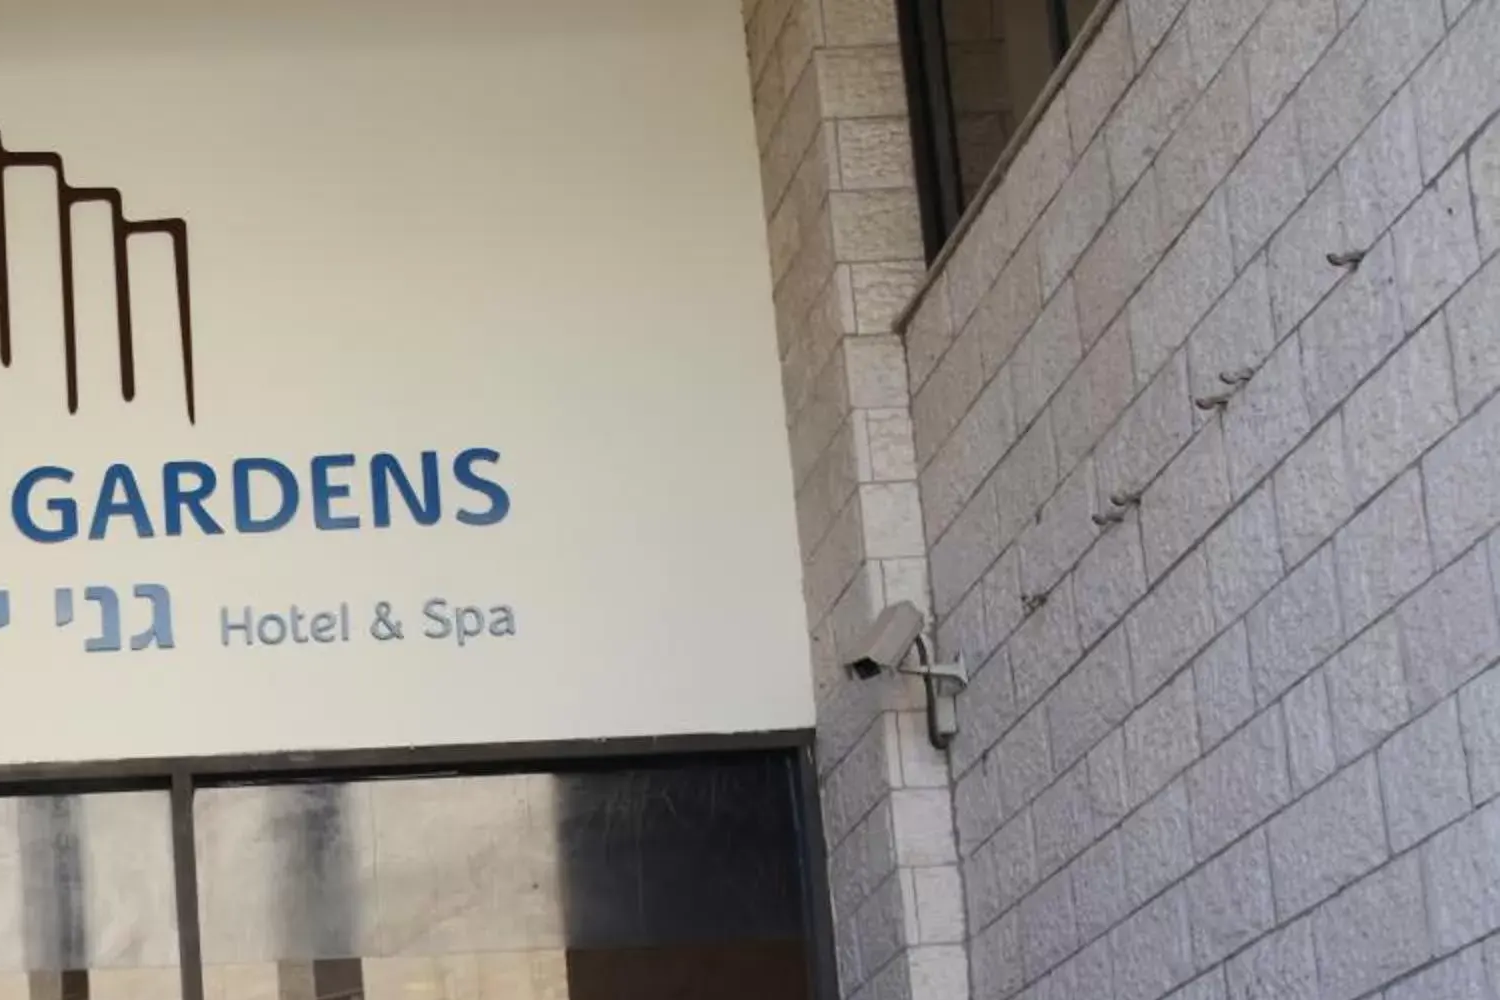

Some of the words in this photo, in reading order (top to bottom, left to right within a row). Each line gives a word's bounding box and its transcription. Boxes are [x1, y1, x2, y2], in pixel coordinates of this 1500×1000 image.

[10, 447, 511, 544] GARDENS
[54, 583, 176, 654] גני
[220, 602, 350, 647] Hotel
[369, 600, 405, 641] &
[422, 597, 517, 648] Spa
